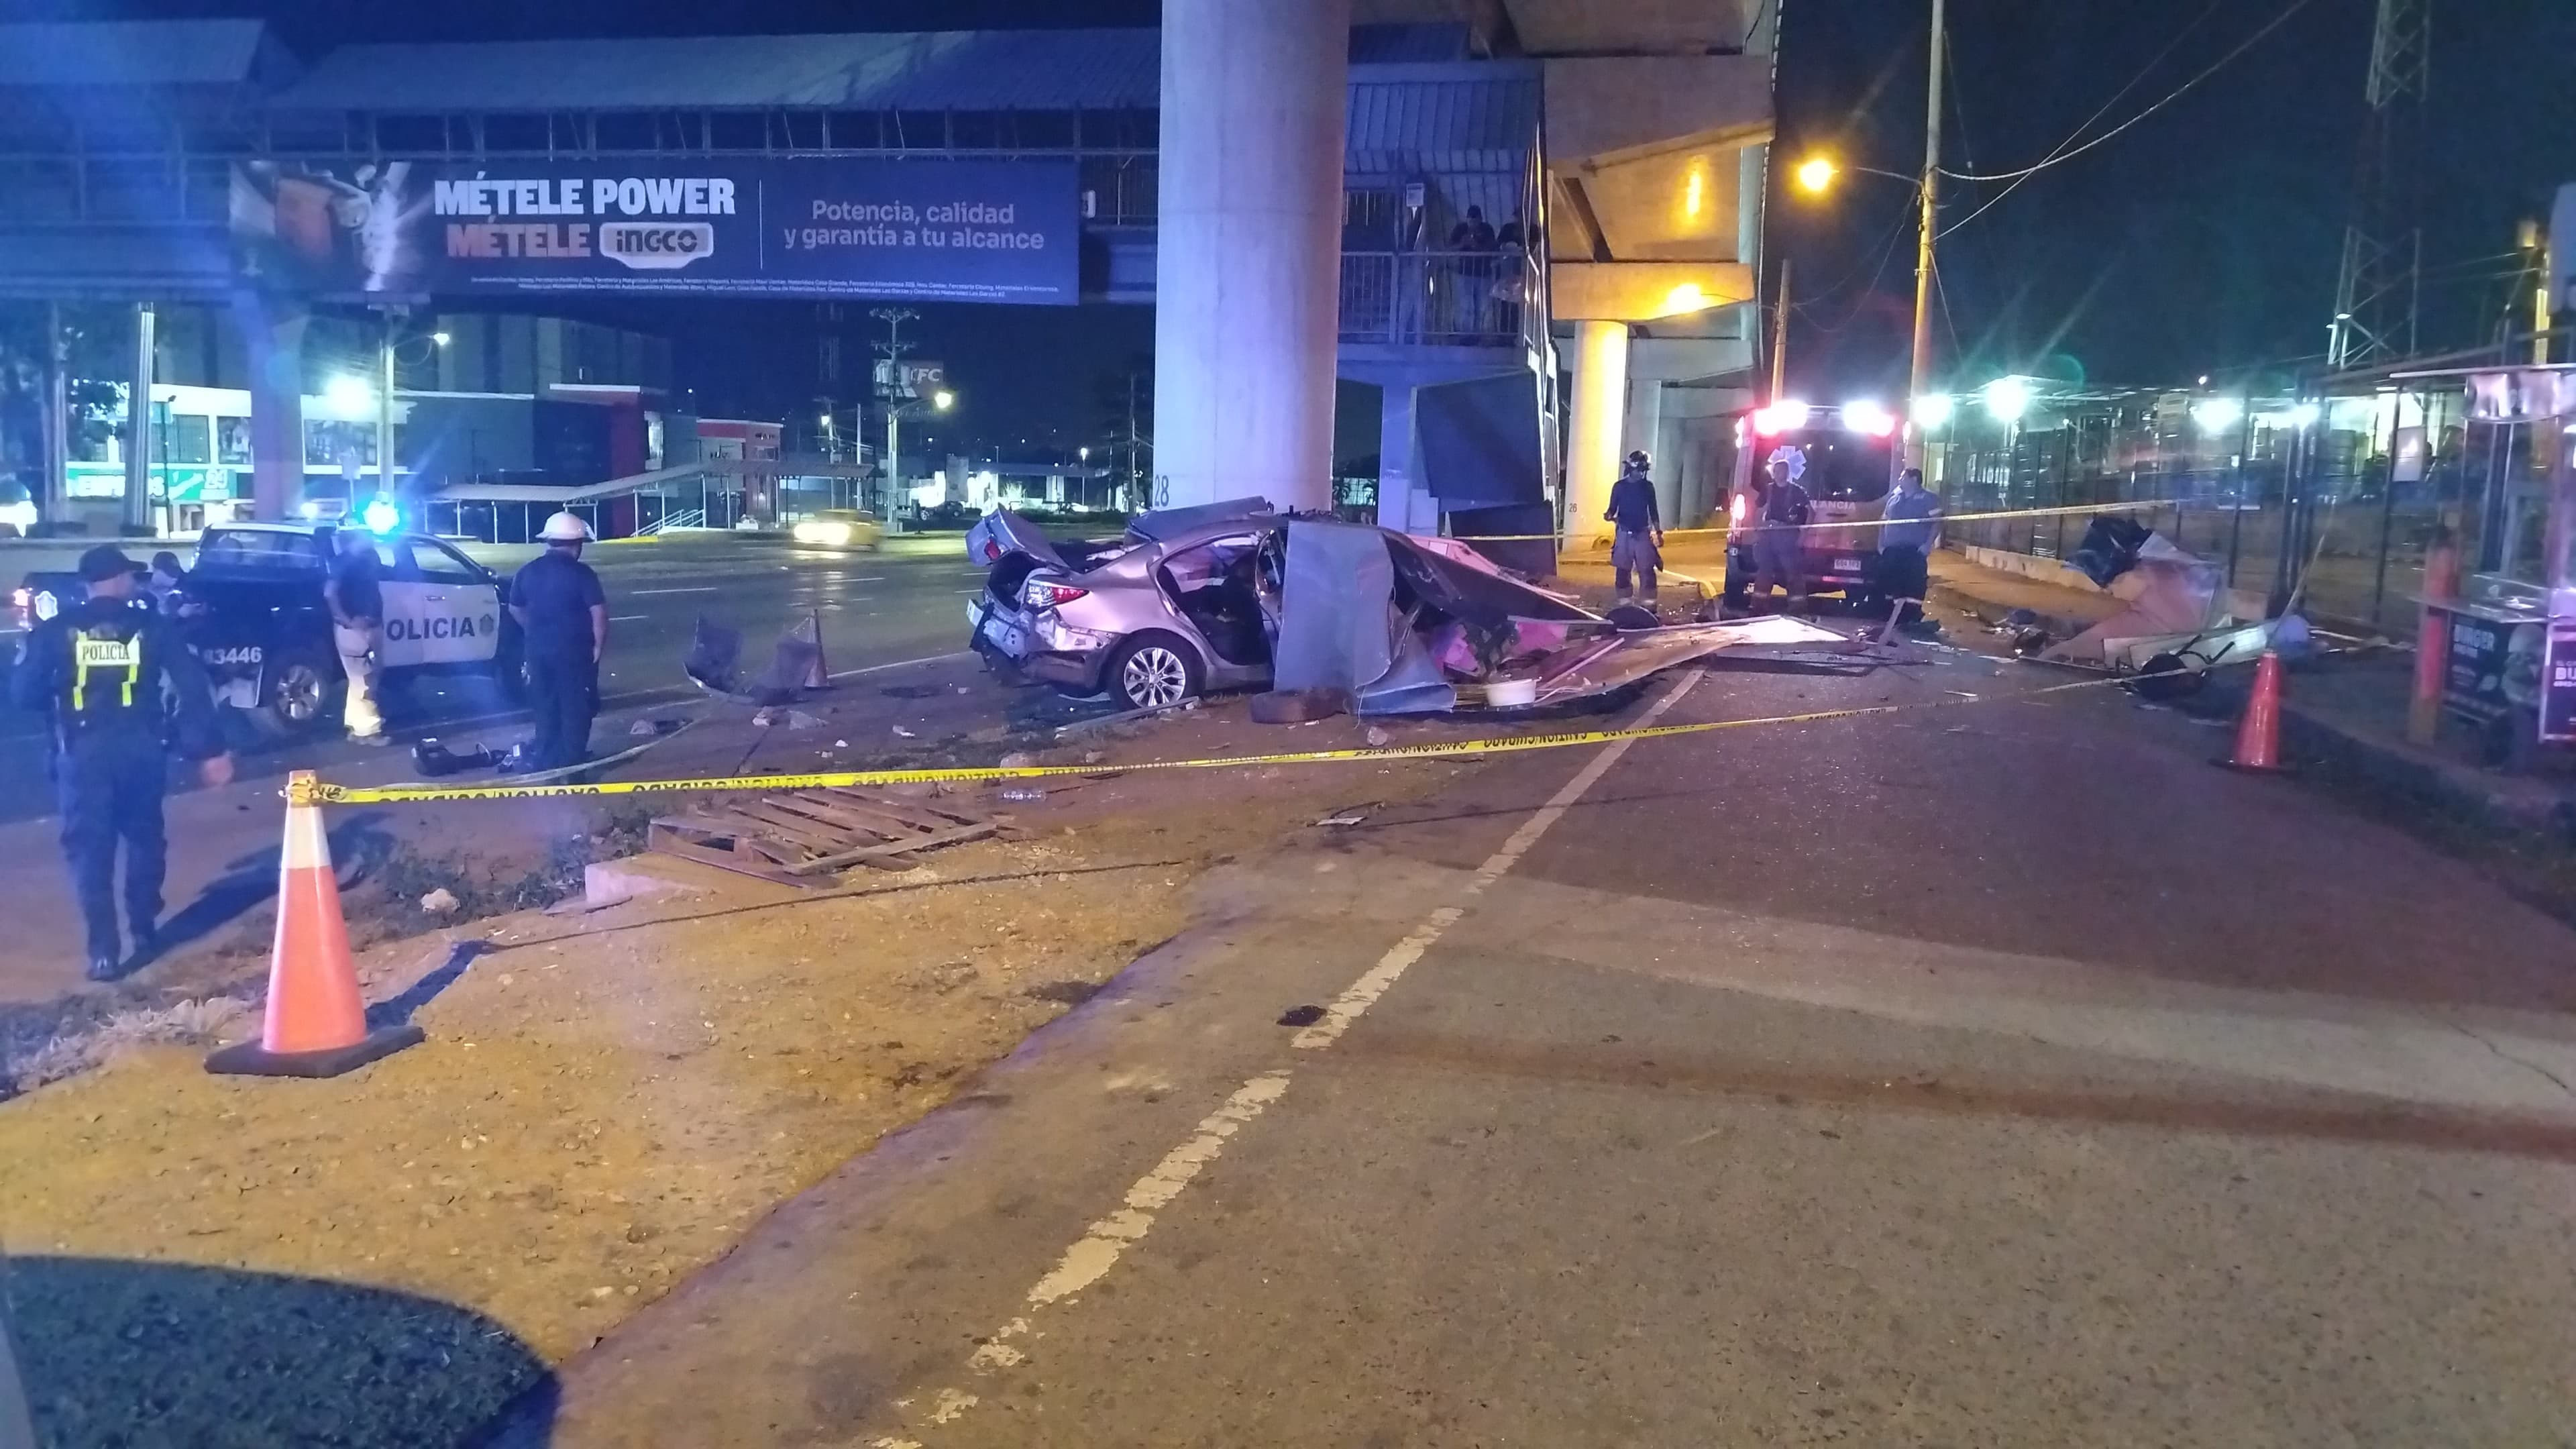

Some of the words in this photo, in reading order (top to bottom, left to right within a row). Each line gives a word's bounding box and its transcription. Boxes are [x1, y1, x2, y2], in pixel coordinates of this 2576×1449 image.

[435, 171, 584, 215] MÉTELE
[593, 178, 735, 215] POWER
[812, 200, 921, 225] Potencia,
[926, 203, 1014, 223] calidad
[447, 215, 590, 257] MÉTELE
[785, 229, 796, 250] y
[802, 223, 896, 250] garantía
[903, 231, 916, 246] a
[922, 228, 945, 246] tu
[952, 229, 1044, 250] alcance
[1155, 474, 1169, 506] 28
[1569, 503, 1577, 513] 26
[1809, 500, 1856, 511] LANCIA
[386, 616, 475, 641] OLICIA
[83, 644, 130, 661] POLICIA
